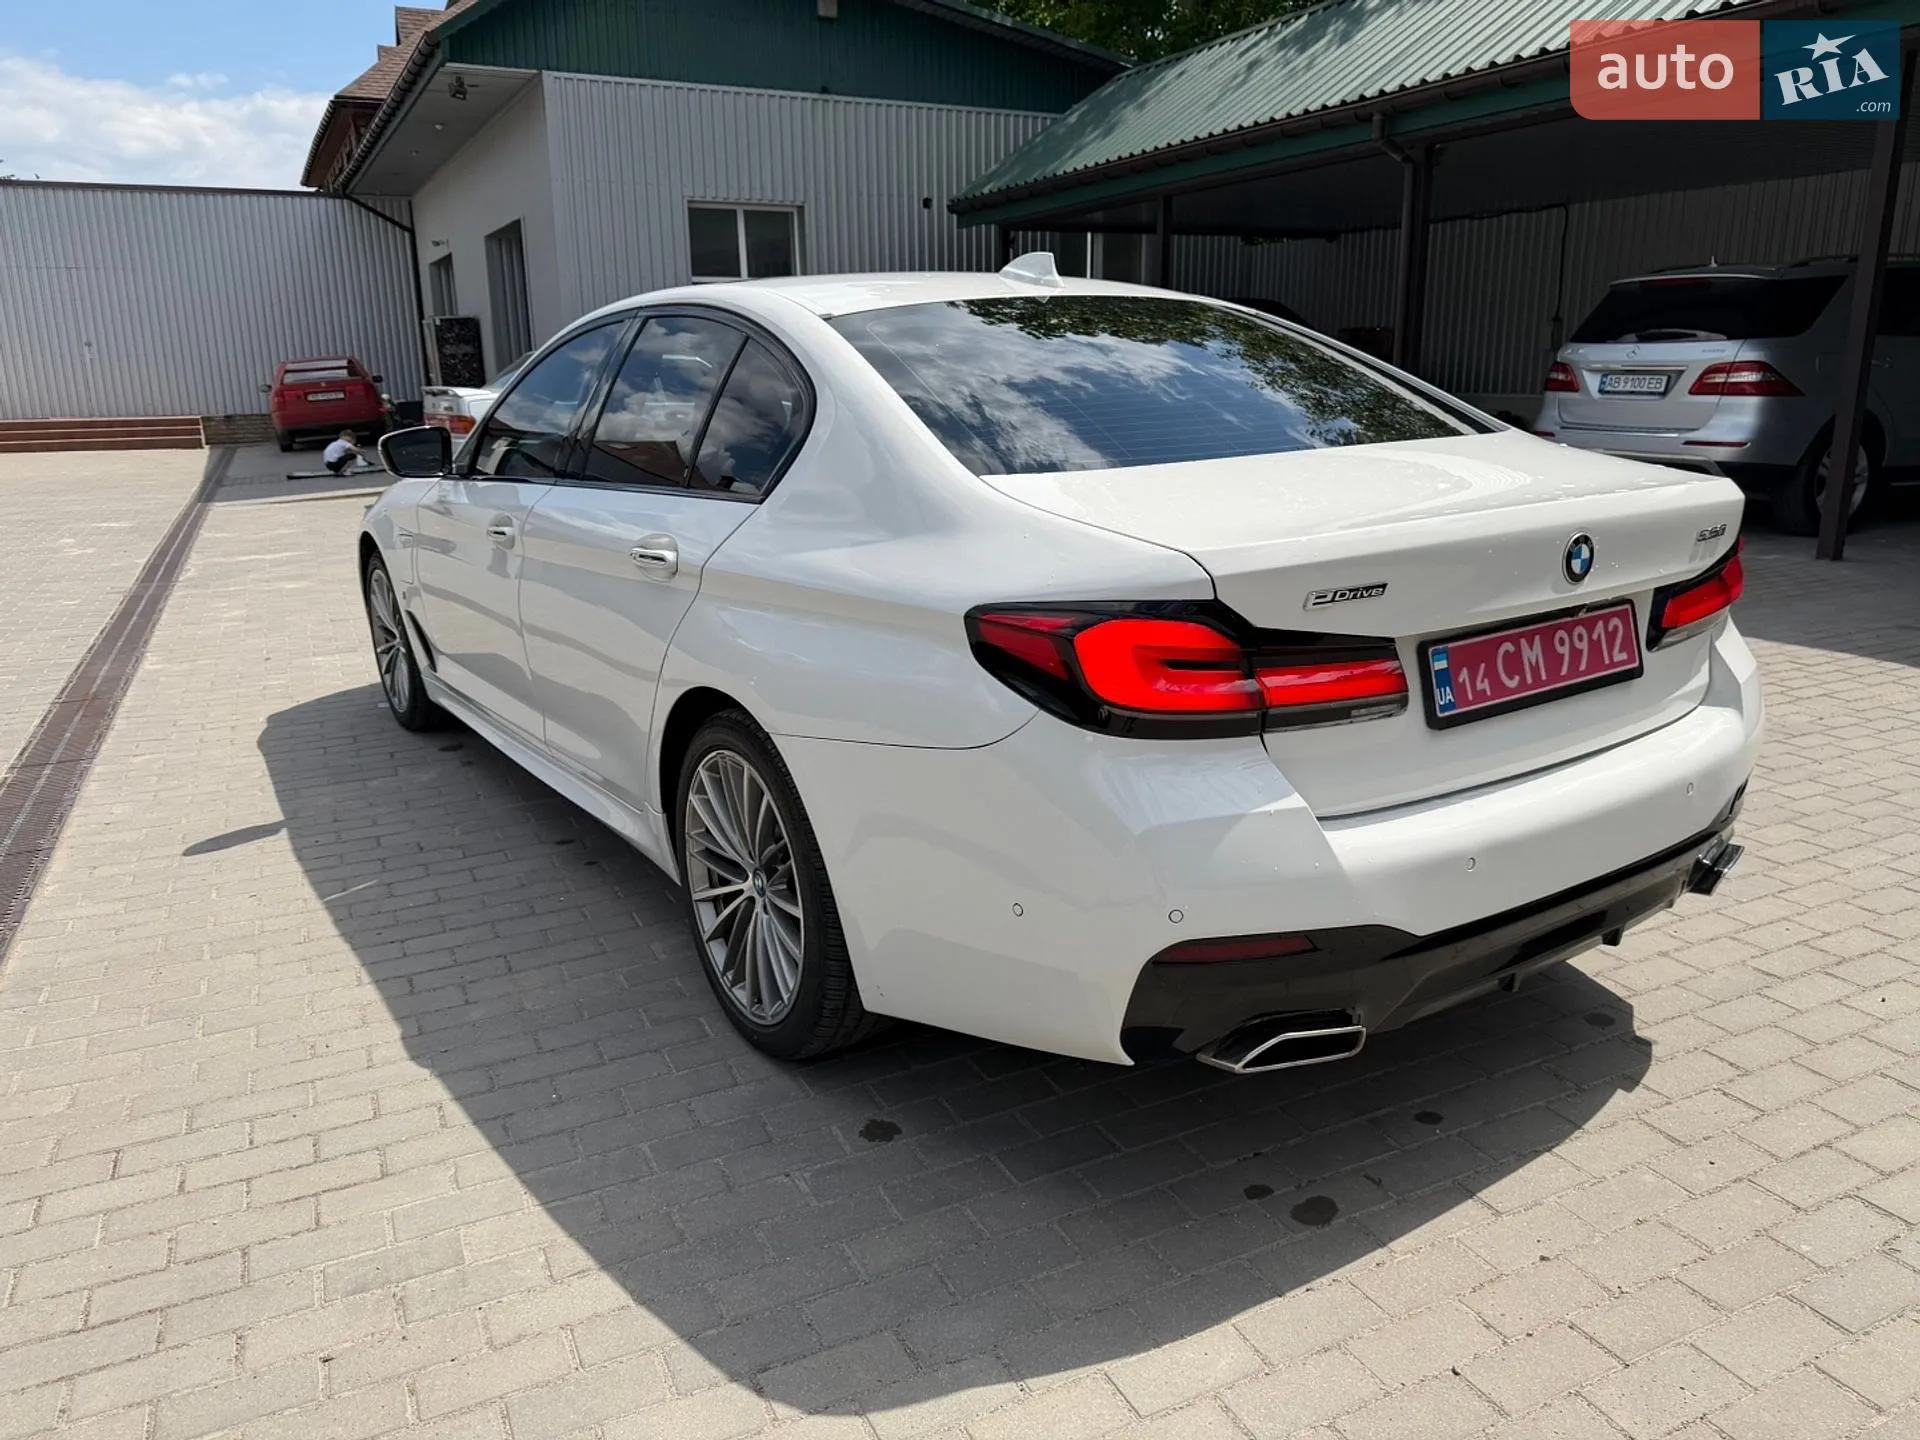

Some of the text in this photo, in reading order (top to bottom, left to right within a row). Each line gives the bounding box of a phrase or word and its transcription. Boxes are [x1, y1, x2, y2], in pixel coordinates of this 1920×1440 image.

[1607, 375, 1663, 390] AB 9100 EB
[1458, 616, 1628, 701] 14 CM 9912
[1437, 687, 1455, 706] UA
